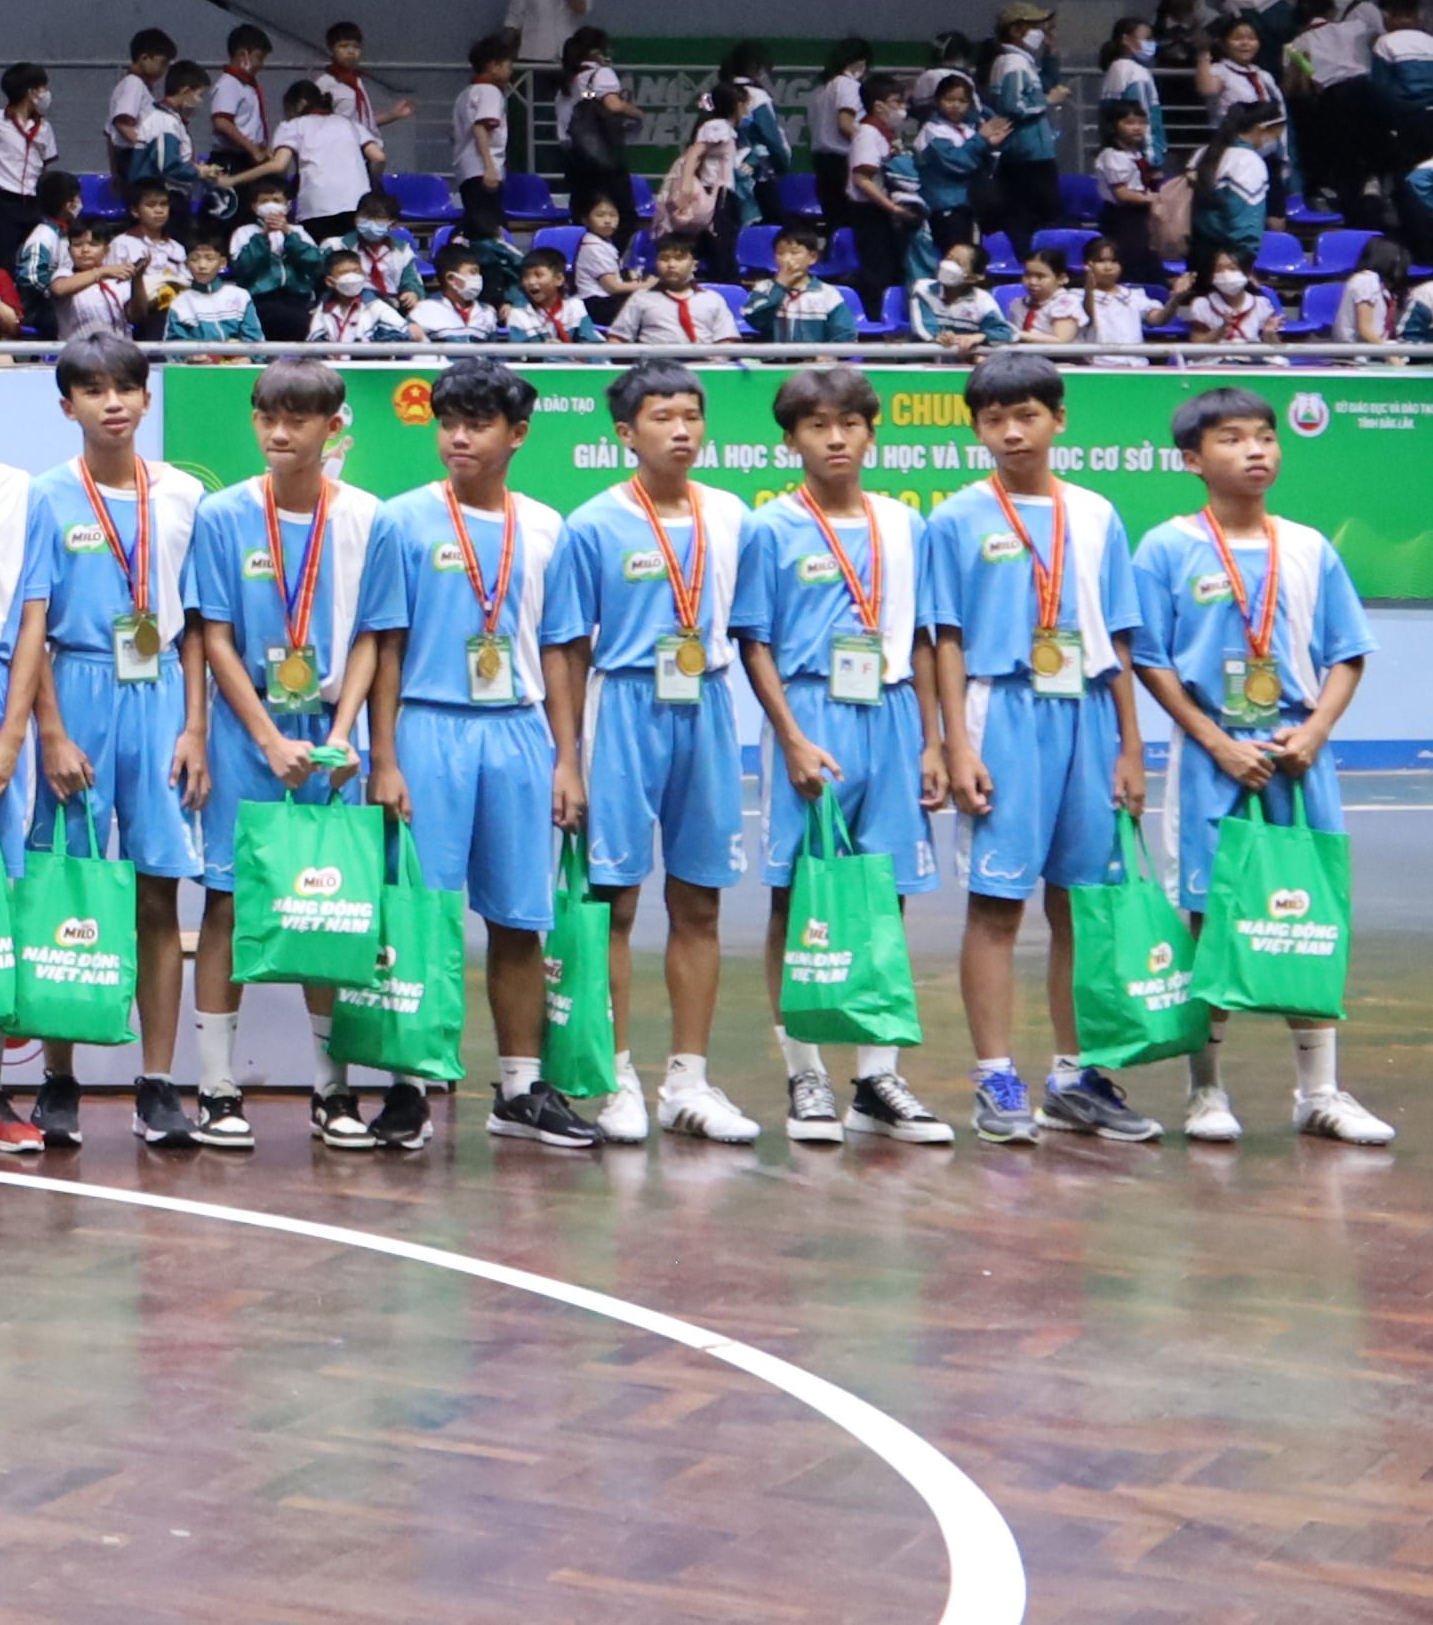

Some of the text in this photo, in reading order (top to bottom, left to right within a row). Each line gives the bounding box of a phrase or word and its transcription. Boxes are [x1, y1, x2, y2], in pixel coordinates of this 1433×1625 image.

[543, 393, 595, 415] ĐÀO TẠO
[892, 393, 975, 426] CHUN
[574, 434, 618, 468] GIẢI
[724, 444, 767, 473] HỌC
[883, 441, 961, 474] HỌC VÀ
[1089, 439, 1154, 472] CƠ SỞ
[72, 530, 101, 541] MILO
[632, 557, 661, 570] MILO
